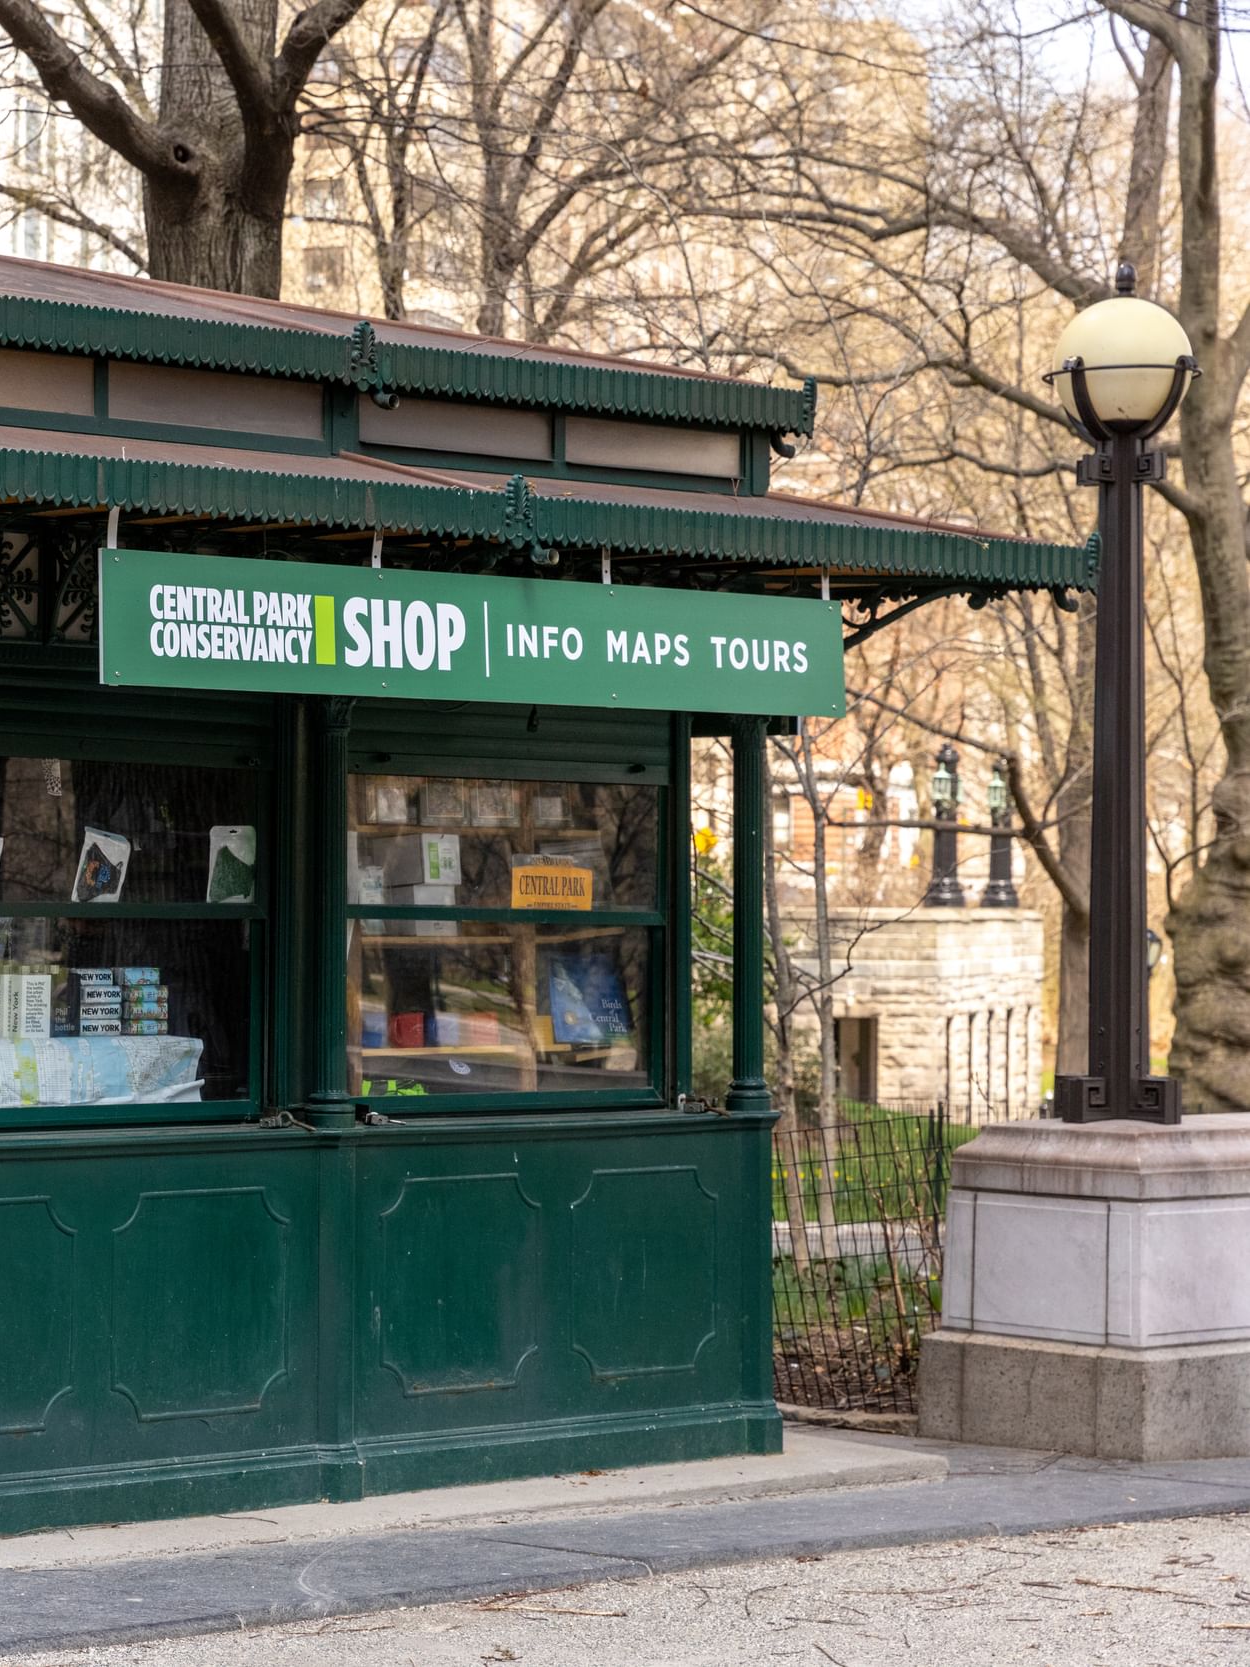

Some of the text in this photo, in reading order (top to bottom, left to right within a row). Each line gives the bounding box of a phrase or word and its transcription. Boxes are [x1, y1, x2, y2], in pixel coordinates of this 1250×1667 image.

[149, 583, 313, 628] CENTRAL PARK
[342, 596, 466, 671] SHOP
[149, 621, 313, 664] CONSERVANCY
[507, 623, 809, 674] INFO MAPS TOURS
[519, 875, 586, 897] CENTRAL PARK
[95, 973, 112, 981] YORK
[87, 991, 102, 999] NEW
[601, 999, 623, 1009] Birds
[55, 1007, 69, 1016] Phil
[82, 1007, 119, 1015] NEW YORK
[54, 1023, 75, 1032] bottle
[82, 1023, 120, 1032] NEW YORK
